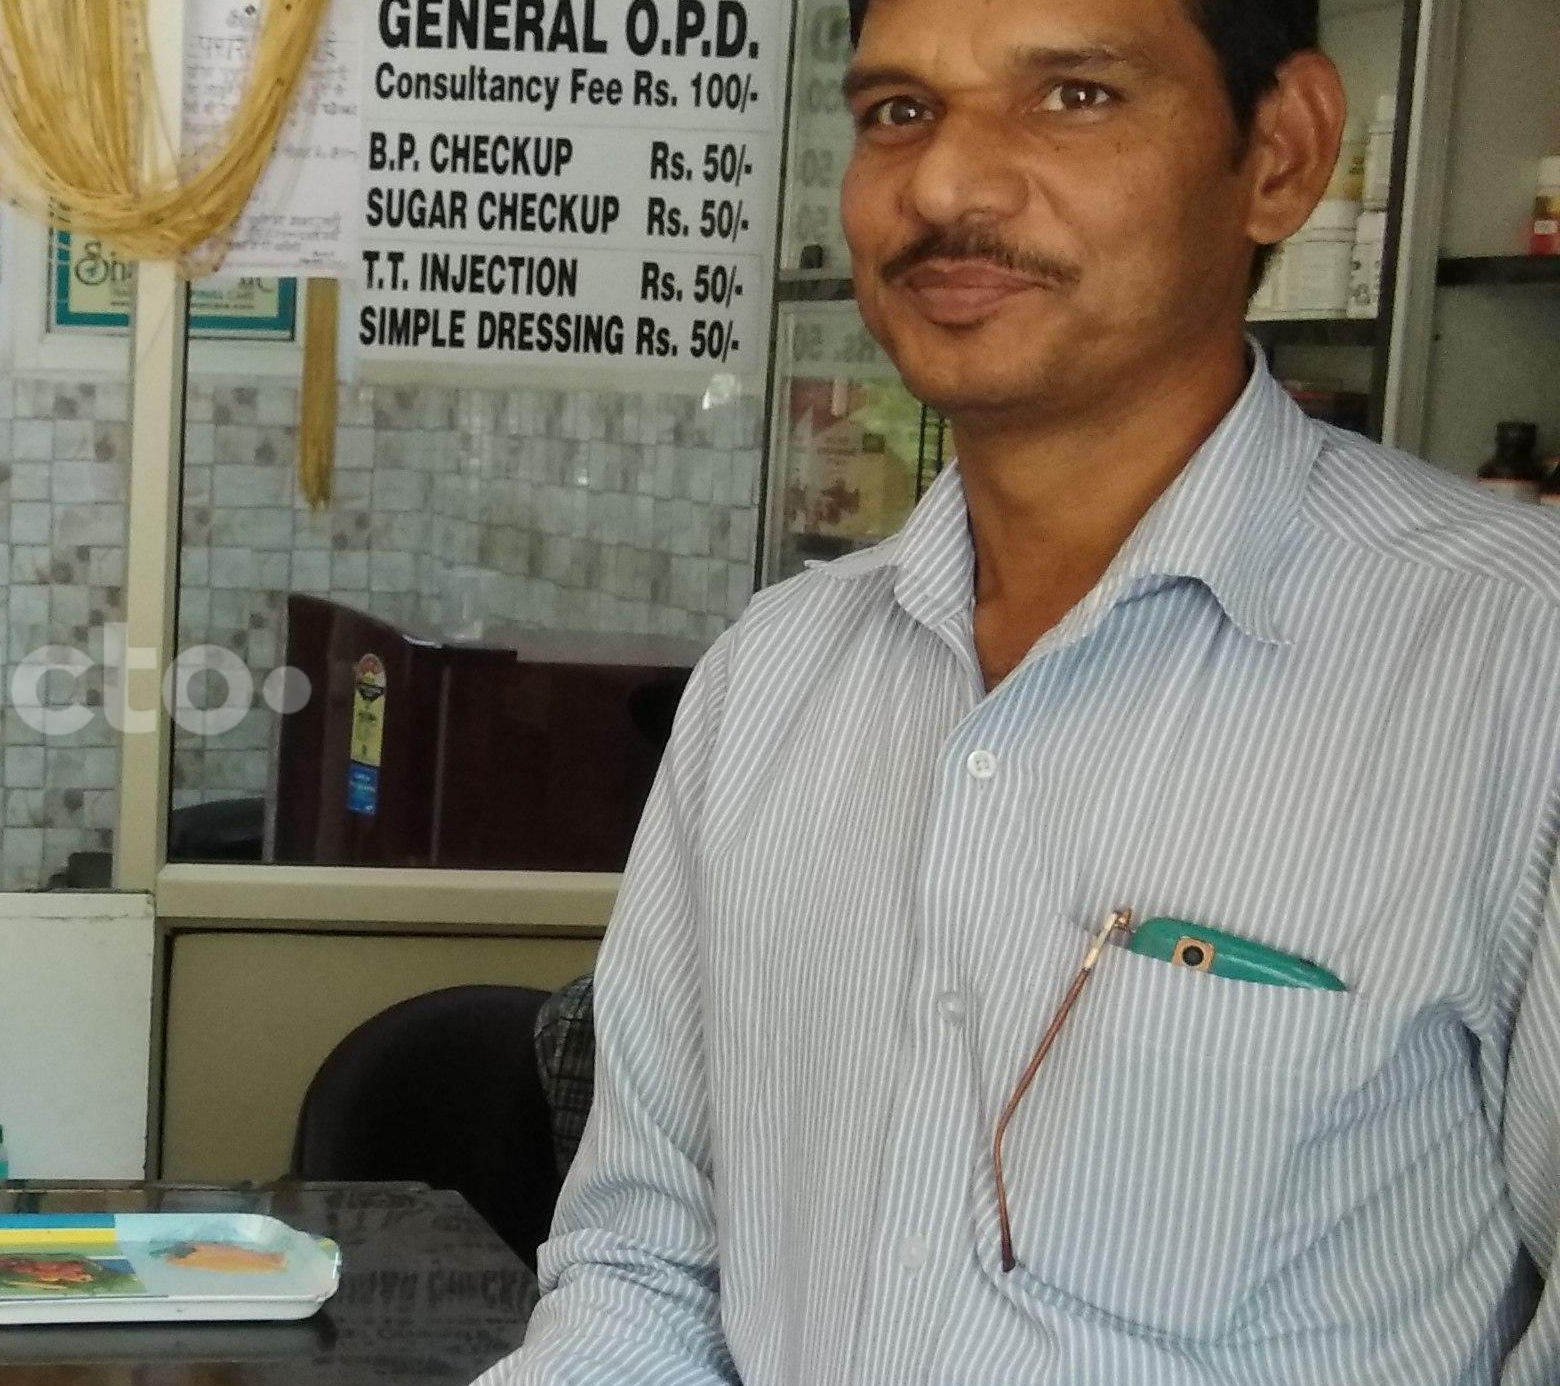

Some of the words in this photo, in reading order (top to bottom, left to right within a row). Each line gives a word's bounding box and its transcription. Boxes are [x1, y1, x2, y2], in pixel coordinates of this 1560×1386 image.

[375, 62, 560, 112] Consultancy
[570, 67, 624, 106] Fee
[633, 69, 678, 108] Rs.
[690, 71, 758, 114] 100/-
[369, 131, 420, 172] B.P.
[430, 132, 573, 177] CHECKUP
[650, 140, 693, 182] Rs.
[702, 143, 753, 187] 50/-
[365, 186, 468, 230] SUGAR
[477, 190, 620, 235] CHECKUP
[646, 196, 689, 238] Rs.
[699, 199, 749, 243] 50/-
[362, 250, 409, 291] T.T.
[419, 252, 578, 298] INJECTION
[640, 261, 683, 302] Rs.
[693, 264, 743, 309] 50/-
[359, 305, 466, 349] SIMPLE
[476, 310, 625, 356] DRESSING
[635, 316, 678, 358] Rs.
[689, 319, 740, 364] 50/-
